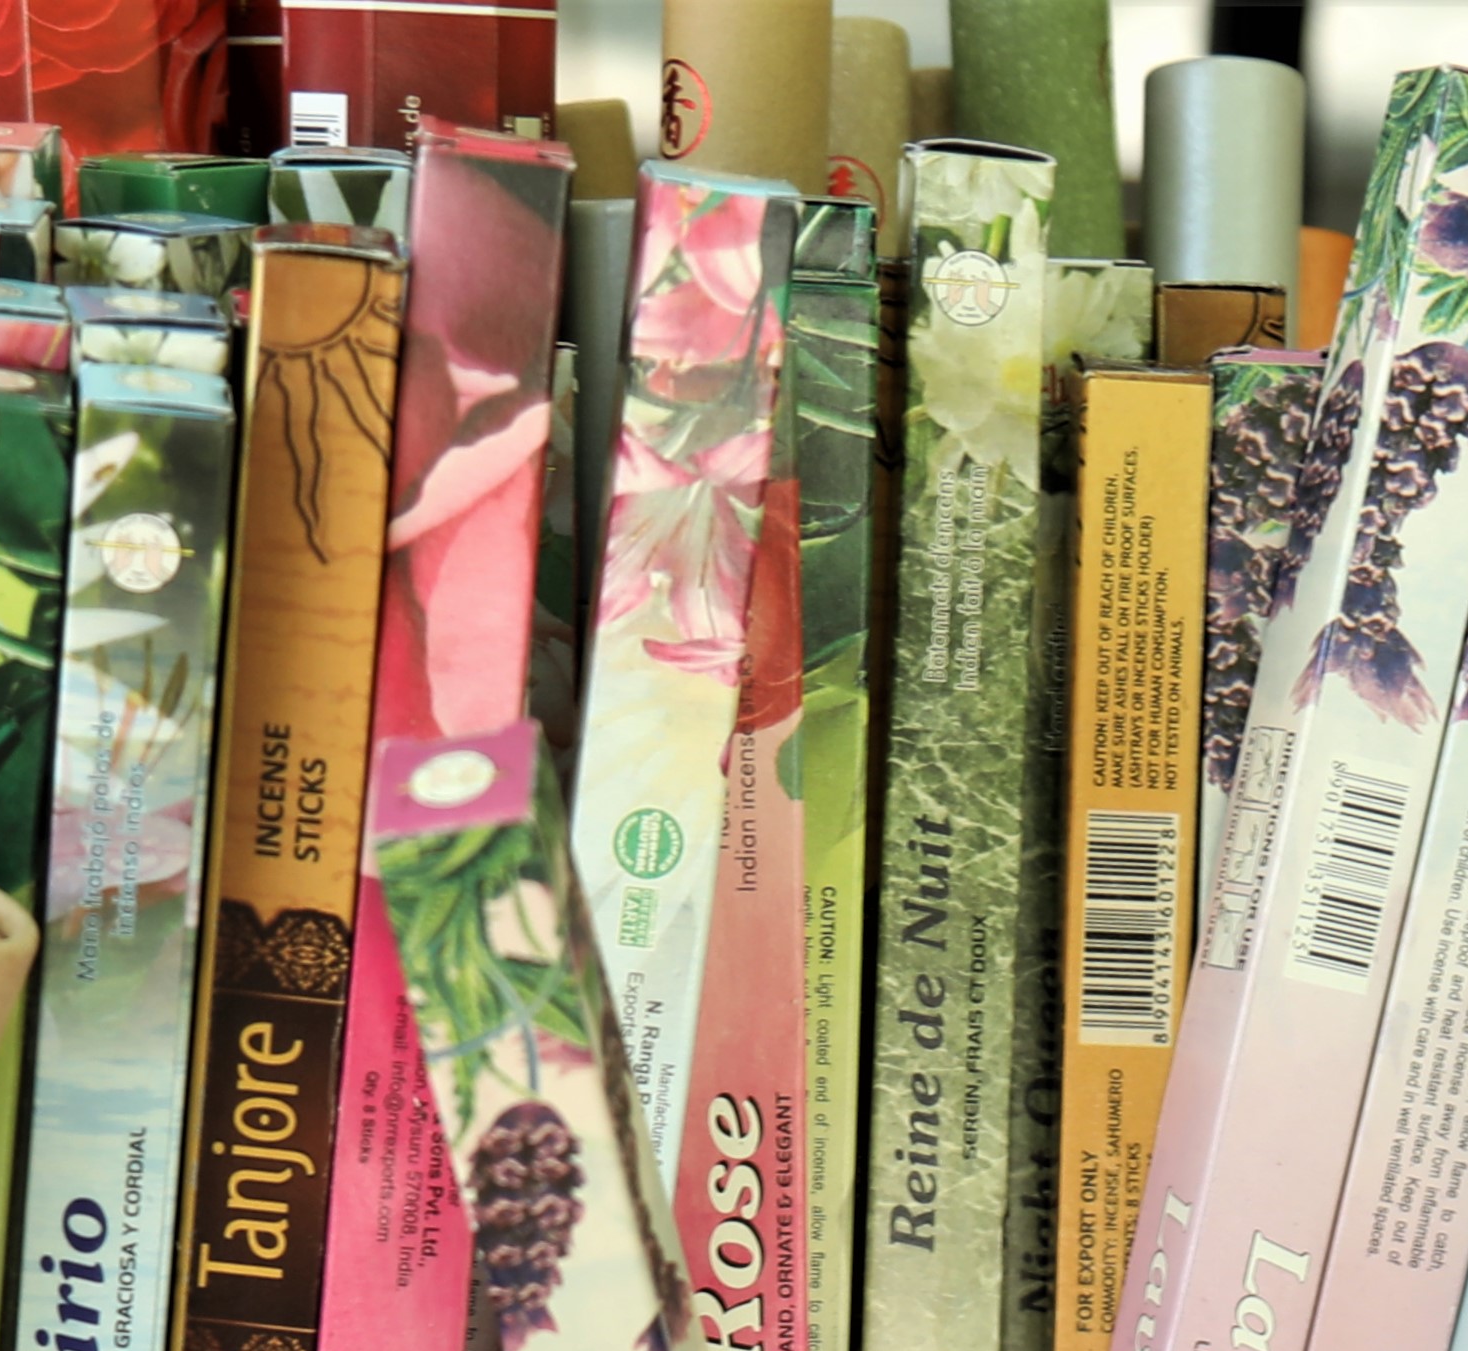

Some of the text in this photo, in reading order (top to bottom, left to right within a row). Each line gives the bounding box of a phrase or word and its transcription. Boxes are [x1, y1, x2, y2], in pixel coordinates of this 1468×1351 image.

[1093, 473, 1119, 786] CAUTION: KEEP OUT OF REACH OF CHILDREN.
[1110, 446, 1138, 787] MAKE SURE ASHES FALL ON FIRE PROOF SURFACES.
[1127, 515, 1156, 788] (ASHTRAYS OR INCENSE STICKS HOLDER)
[1144, 567, 1170, 788] NOT FOR HUMAN CONSUMPTION.
[92, 709, 114, 739] de
[1163, 615, 1186, 790] NOT TESTED ON ANIMALS.
[87, 749, 117, 810] palos
[120, 759, 148, 831] indios
[254, 721, 292, 858] INCENSE
[291, 756, 327, 862] STICKS
[736, 722, 757, 891] Indian incense
[76, 912, 100, 980] Mano
[1152, 829, 1177, 1043] 8 904143 601228
[886, 812, 953, 1252] Reine de Nuit
[961, 914, 987, 1159] SEREIN, FRAIS ET DOUX
[122, 1126, 146, 1217] CORDIAL
[195, 1019, 327, 1295] Tanjore
[359, 1118, 374, 1163] Sticks
[362, 1104, 375, 1113] 8
[375, 1060, 406, 1242] info@nrrexports.com
[775, 1091, 792, 1187] ELEGANT
[121, 1223, 139, 1236] Y
[417, 1130, 448, 1268] Sons Pvt. Ltd.,
[776, 1193, 792, 1206] &
[777, 1214, 793, 1298] ORNATE
[1075, 1150, 1099, 1331] FOR EXPORT ONLY
[1100, 1068, 1124, 1333] COMMODITY: INCENSE, SAHUMERIO
[114, 1242, 138, 1347] GRACIOSA
